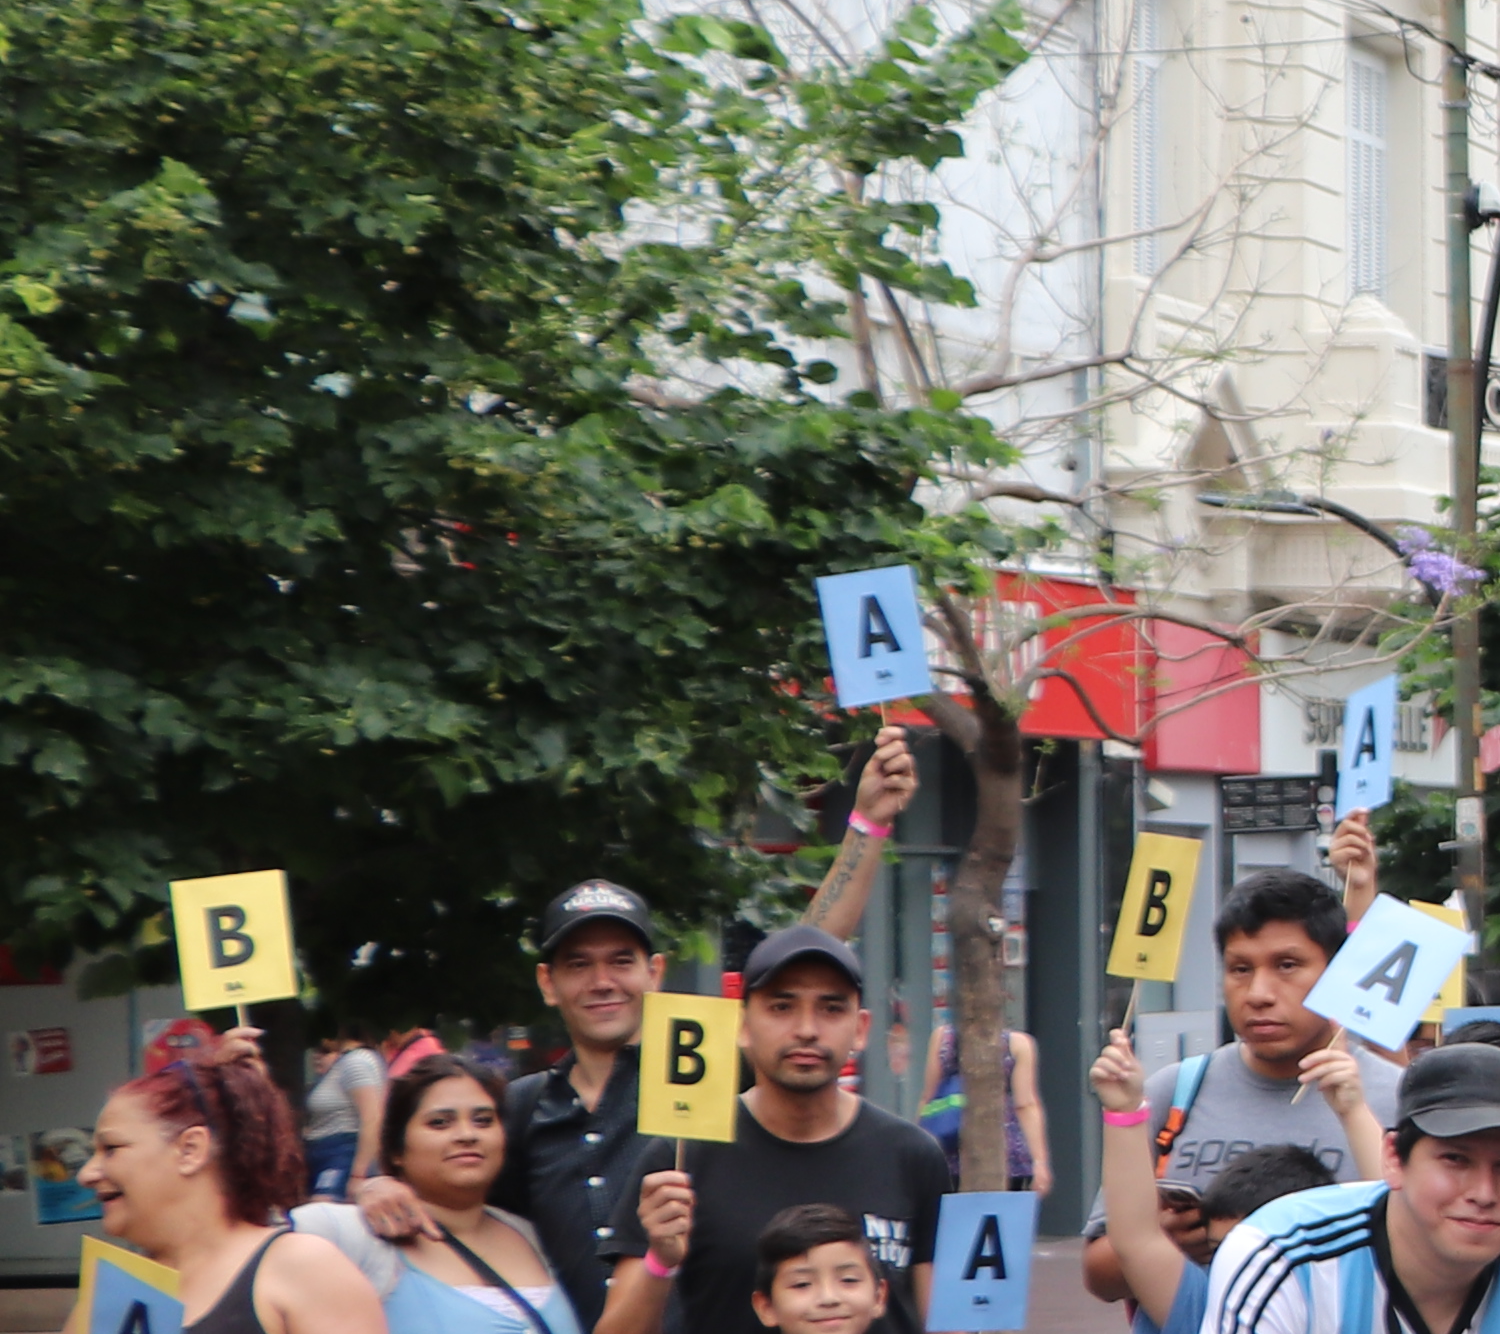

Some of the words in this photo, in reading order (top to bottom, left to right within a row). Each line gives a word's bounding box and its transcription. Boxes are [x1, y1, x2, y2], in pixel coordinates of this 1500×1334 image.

[861, 594, 903, 659] A
[1354, 707, 1377, 768] A
[1137, 869, 1172, 937] B
[207, 905, 255, 969] B
[1357, 940, 1419, 1006] A
[668, 1019, 706, 1086] B
[962, 1214, 1008, 1281] A
